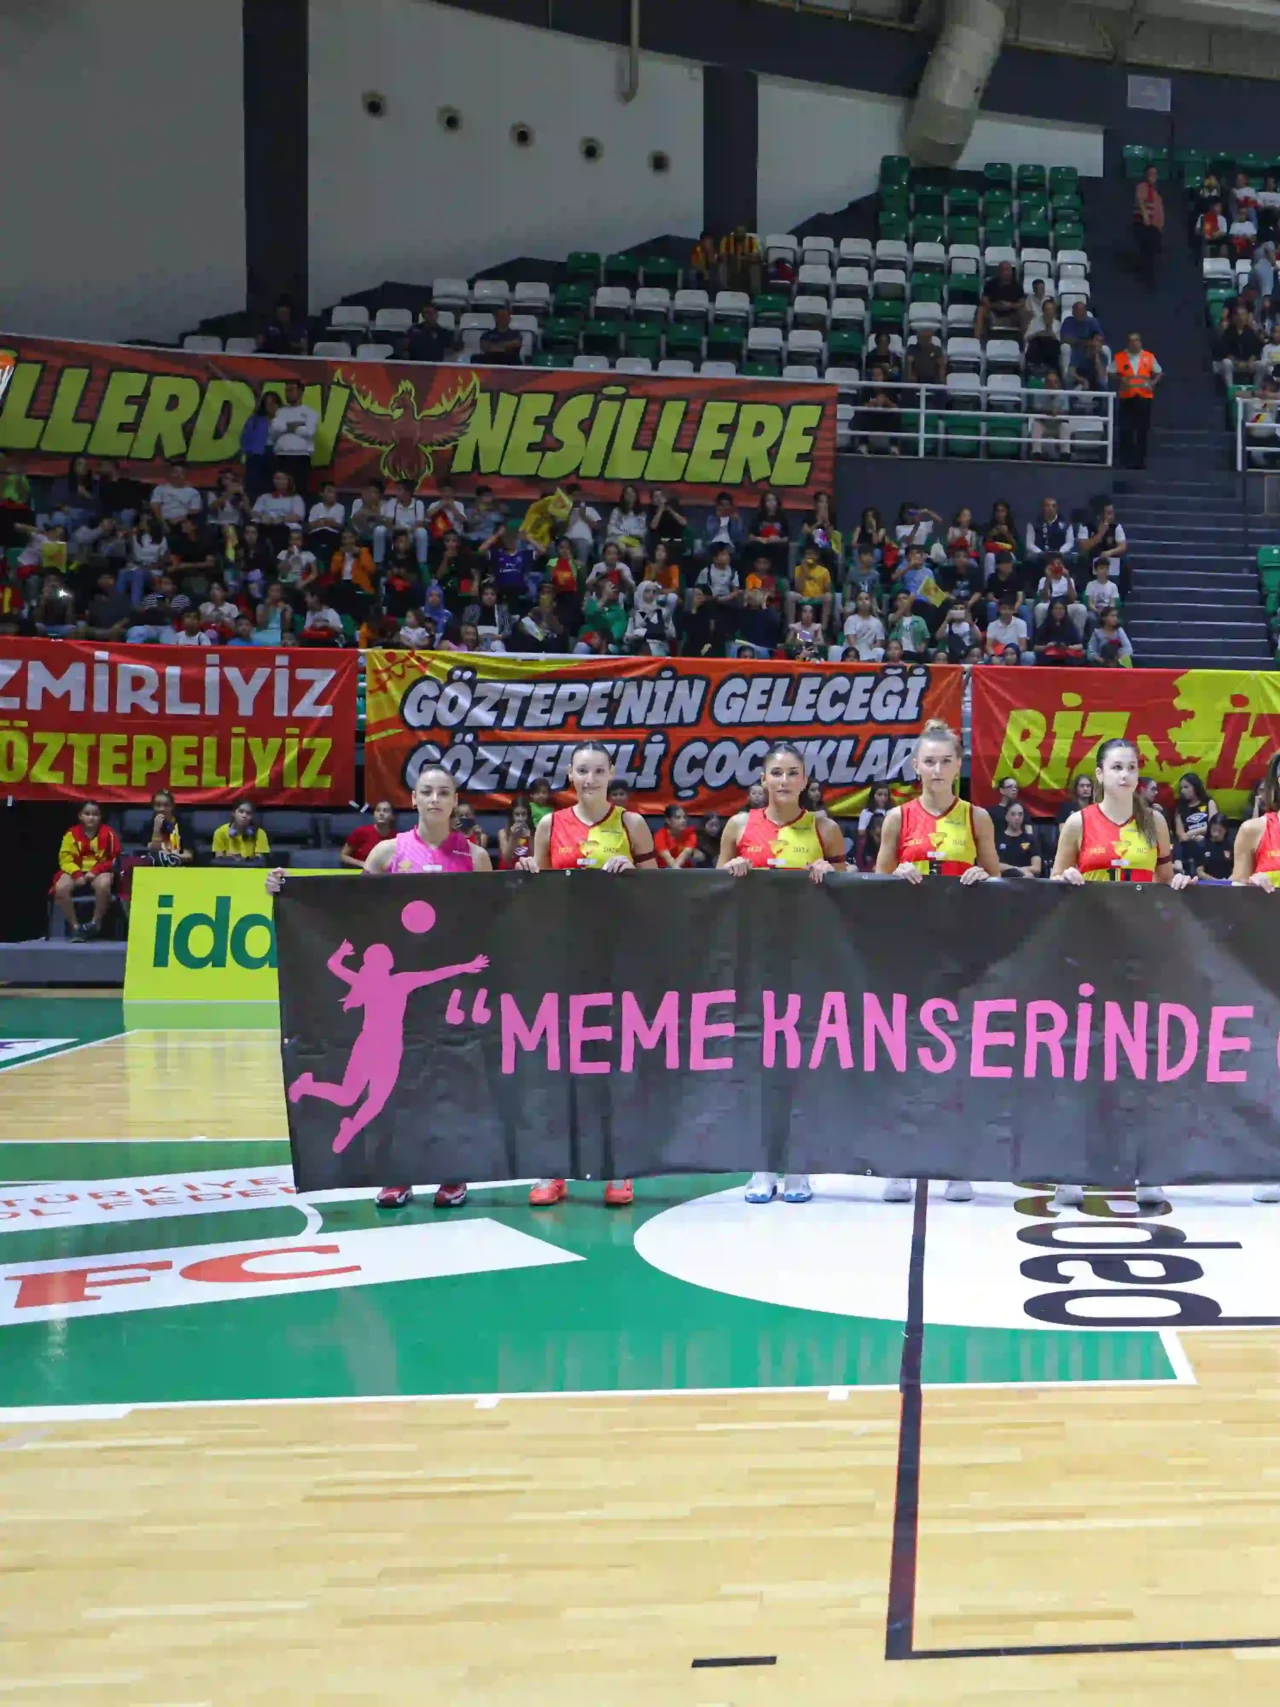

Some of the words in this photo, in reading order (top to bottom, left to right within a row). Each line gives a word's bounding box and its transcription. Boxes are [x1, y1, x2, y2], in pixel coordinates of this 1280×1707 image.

[450, 386, 822, 486] NESİLLERE
[403, 669, 707, 728] GÖZTEPE'NİN
[713, 666, 928, 725] GELECEĞİ
[992, 692, 1131, 789] BİZ
[405, 732, 666, 791] GÖZTELİ
[762, 983, 1254, 1081] KANSERİNDE
